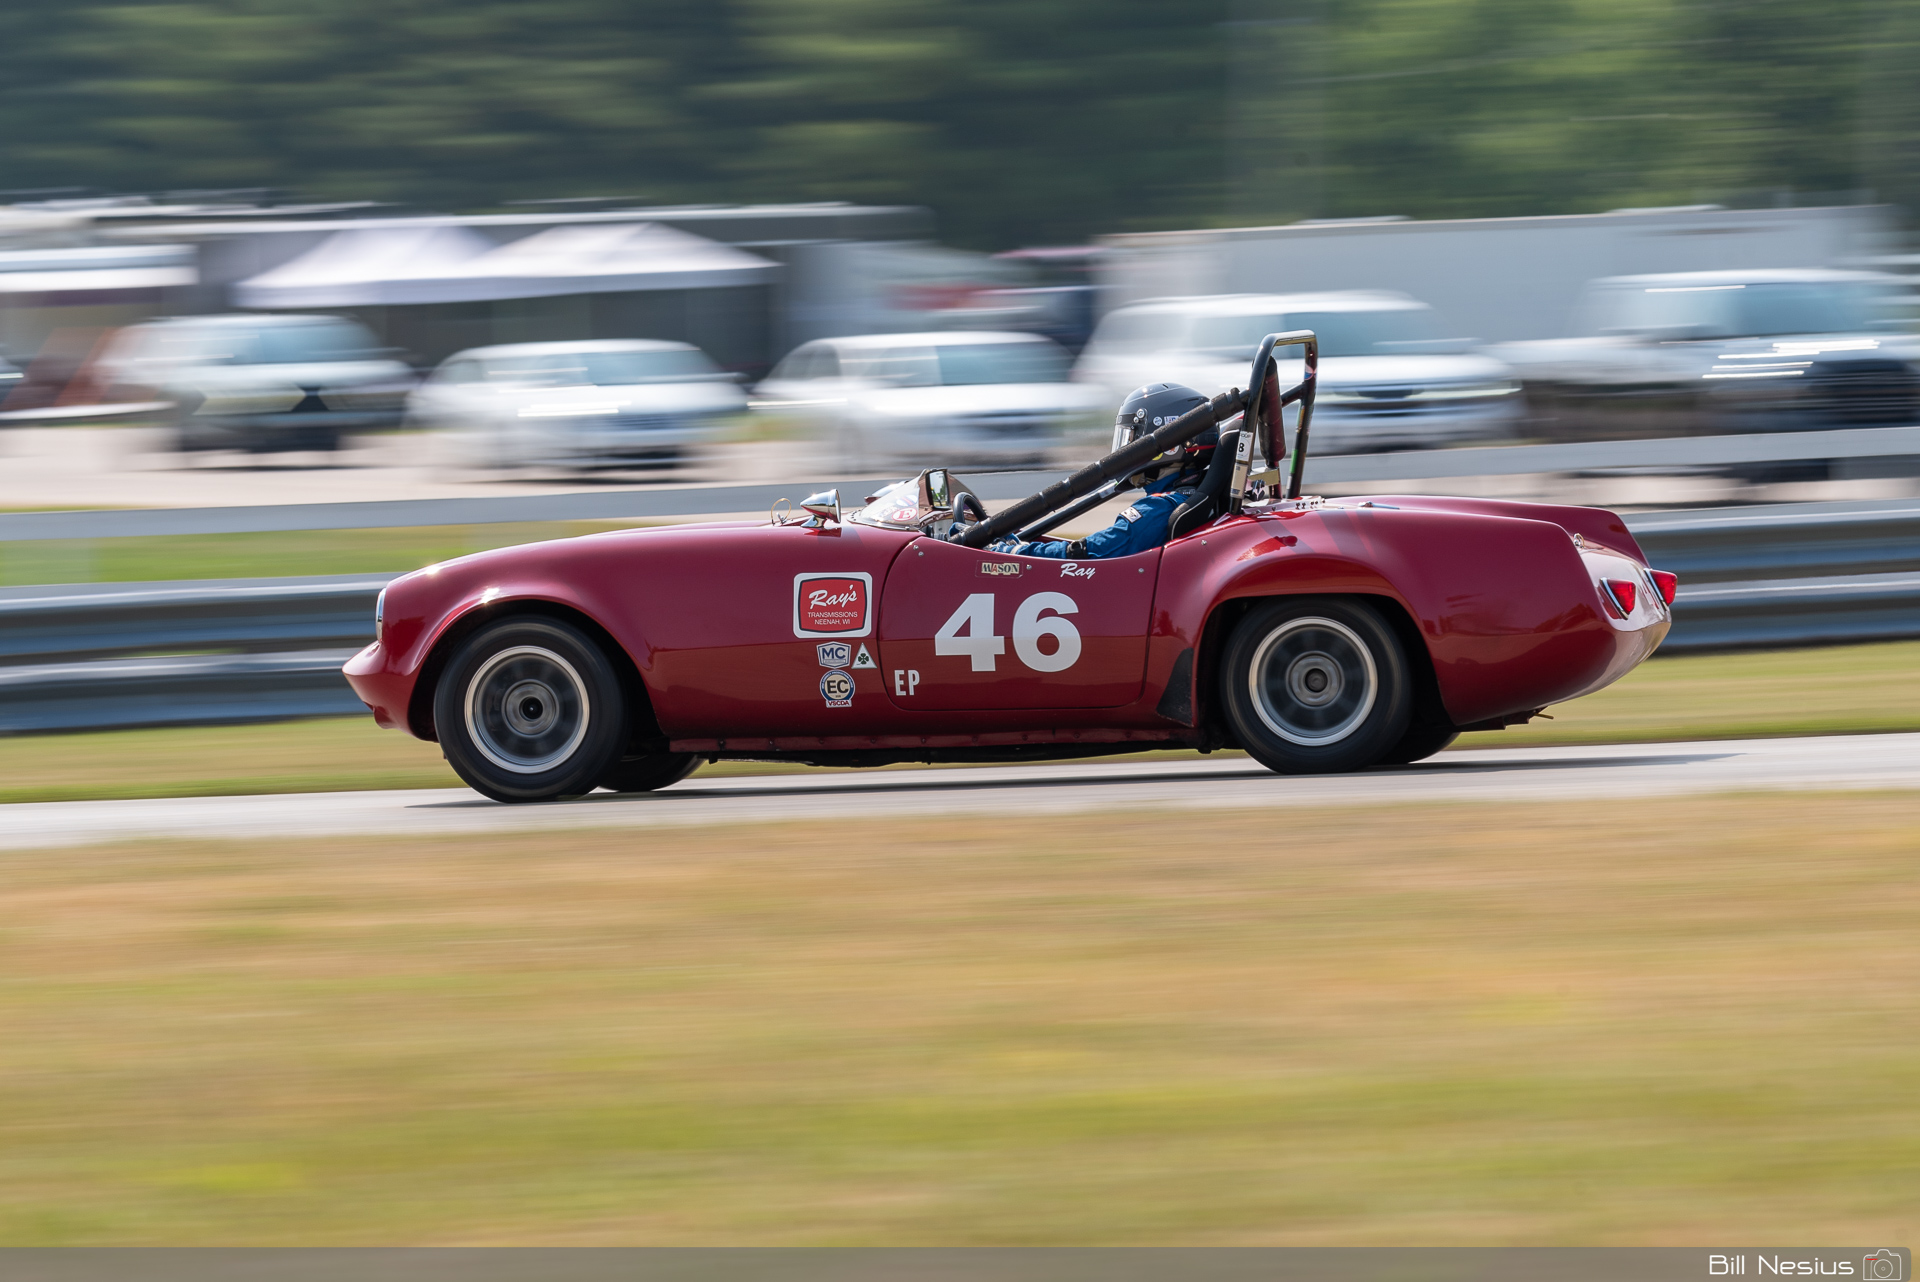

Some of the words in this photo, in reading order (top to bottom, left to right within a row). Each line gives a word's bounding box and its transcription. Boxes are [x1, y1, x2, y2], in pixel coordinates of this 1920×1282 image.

[1238, 442, 1245, 453] 8
[983, 563, 1019, 574] MASON
[1060, 563, 1096, 579] Ray
[808, 584, 858, 609] Ray's
[934, 591, 1082, 673] 46
[821, 647, 846, 660] MC
[826, 679, 849, 694] EC
[894, 669, 920, 696] EP
